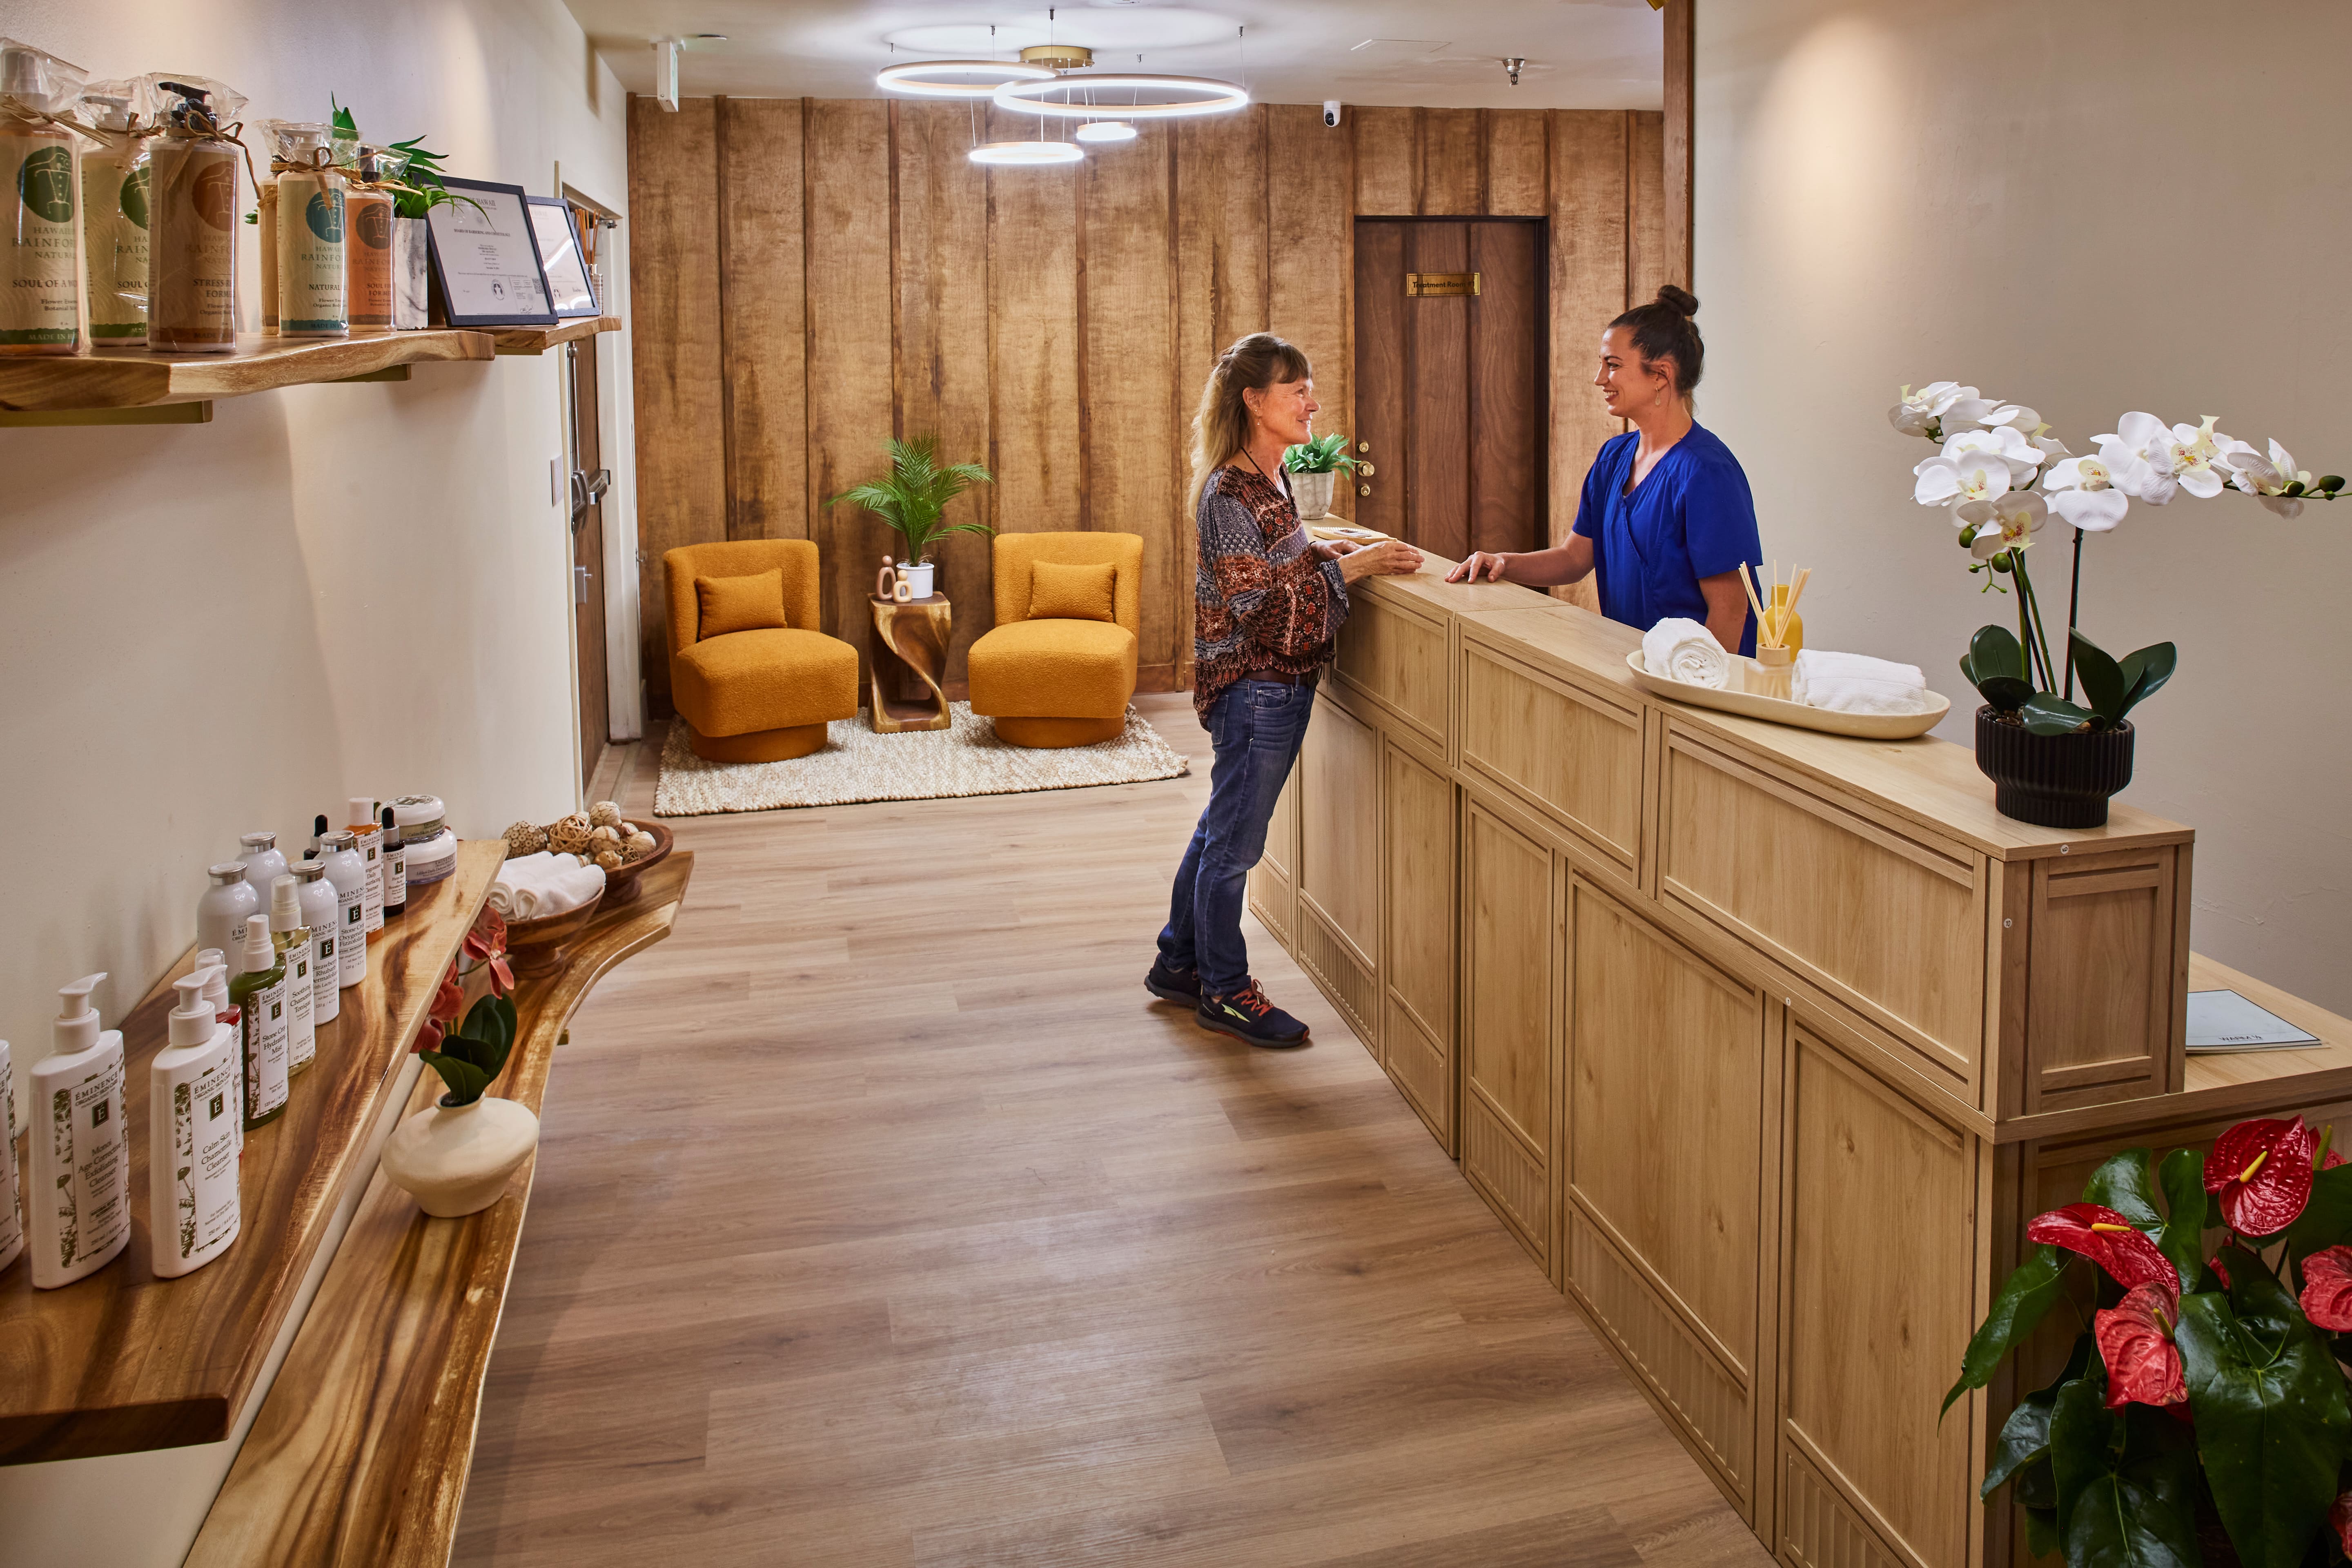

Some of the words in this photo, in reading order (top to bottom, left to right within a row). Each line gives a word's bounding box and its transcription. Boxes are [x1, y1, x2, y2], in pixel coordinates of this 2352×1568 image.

[477, 198, 496, 207] HAWAII
[13, 279, 42, 287] SOUL
[361, 834, 380, 844] ÉMINENCE
[263, 1032, 277, 1042] Stone
[272, 1045, 282, 1055] Mist
[75, 1071, 118, 1101] ÉMINENCE
[194, 1064, 231, 1094] ÉMINENCE
[75, 1091, 99, 1107] ORGANIC
[194, 1084, 215, 1100] ORGANIC
[215, 1079, 224, 1088] SKIN
[98, 1104, 106, 1121] É
[213, 1097, 221, 1114] É
[92, 1138, 112, 1156] Monoi
[201, 1139, 232, 1165] Chamomile
[203, 1140, 220, 1154] Calm
[220, 1131, 231, 1143] Skin
[78, 1162, 93, 1174] Age
[94, 1142, 122, 1165] Corrective
[85, 1155, 119, 1180] Exfoliating
[207, 1151, 229, 1172] Cleanser
[89, 1167, 117, 1187] Cleanser
